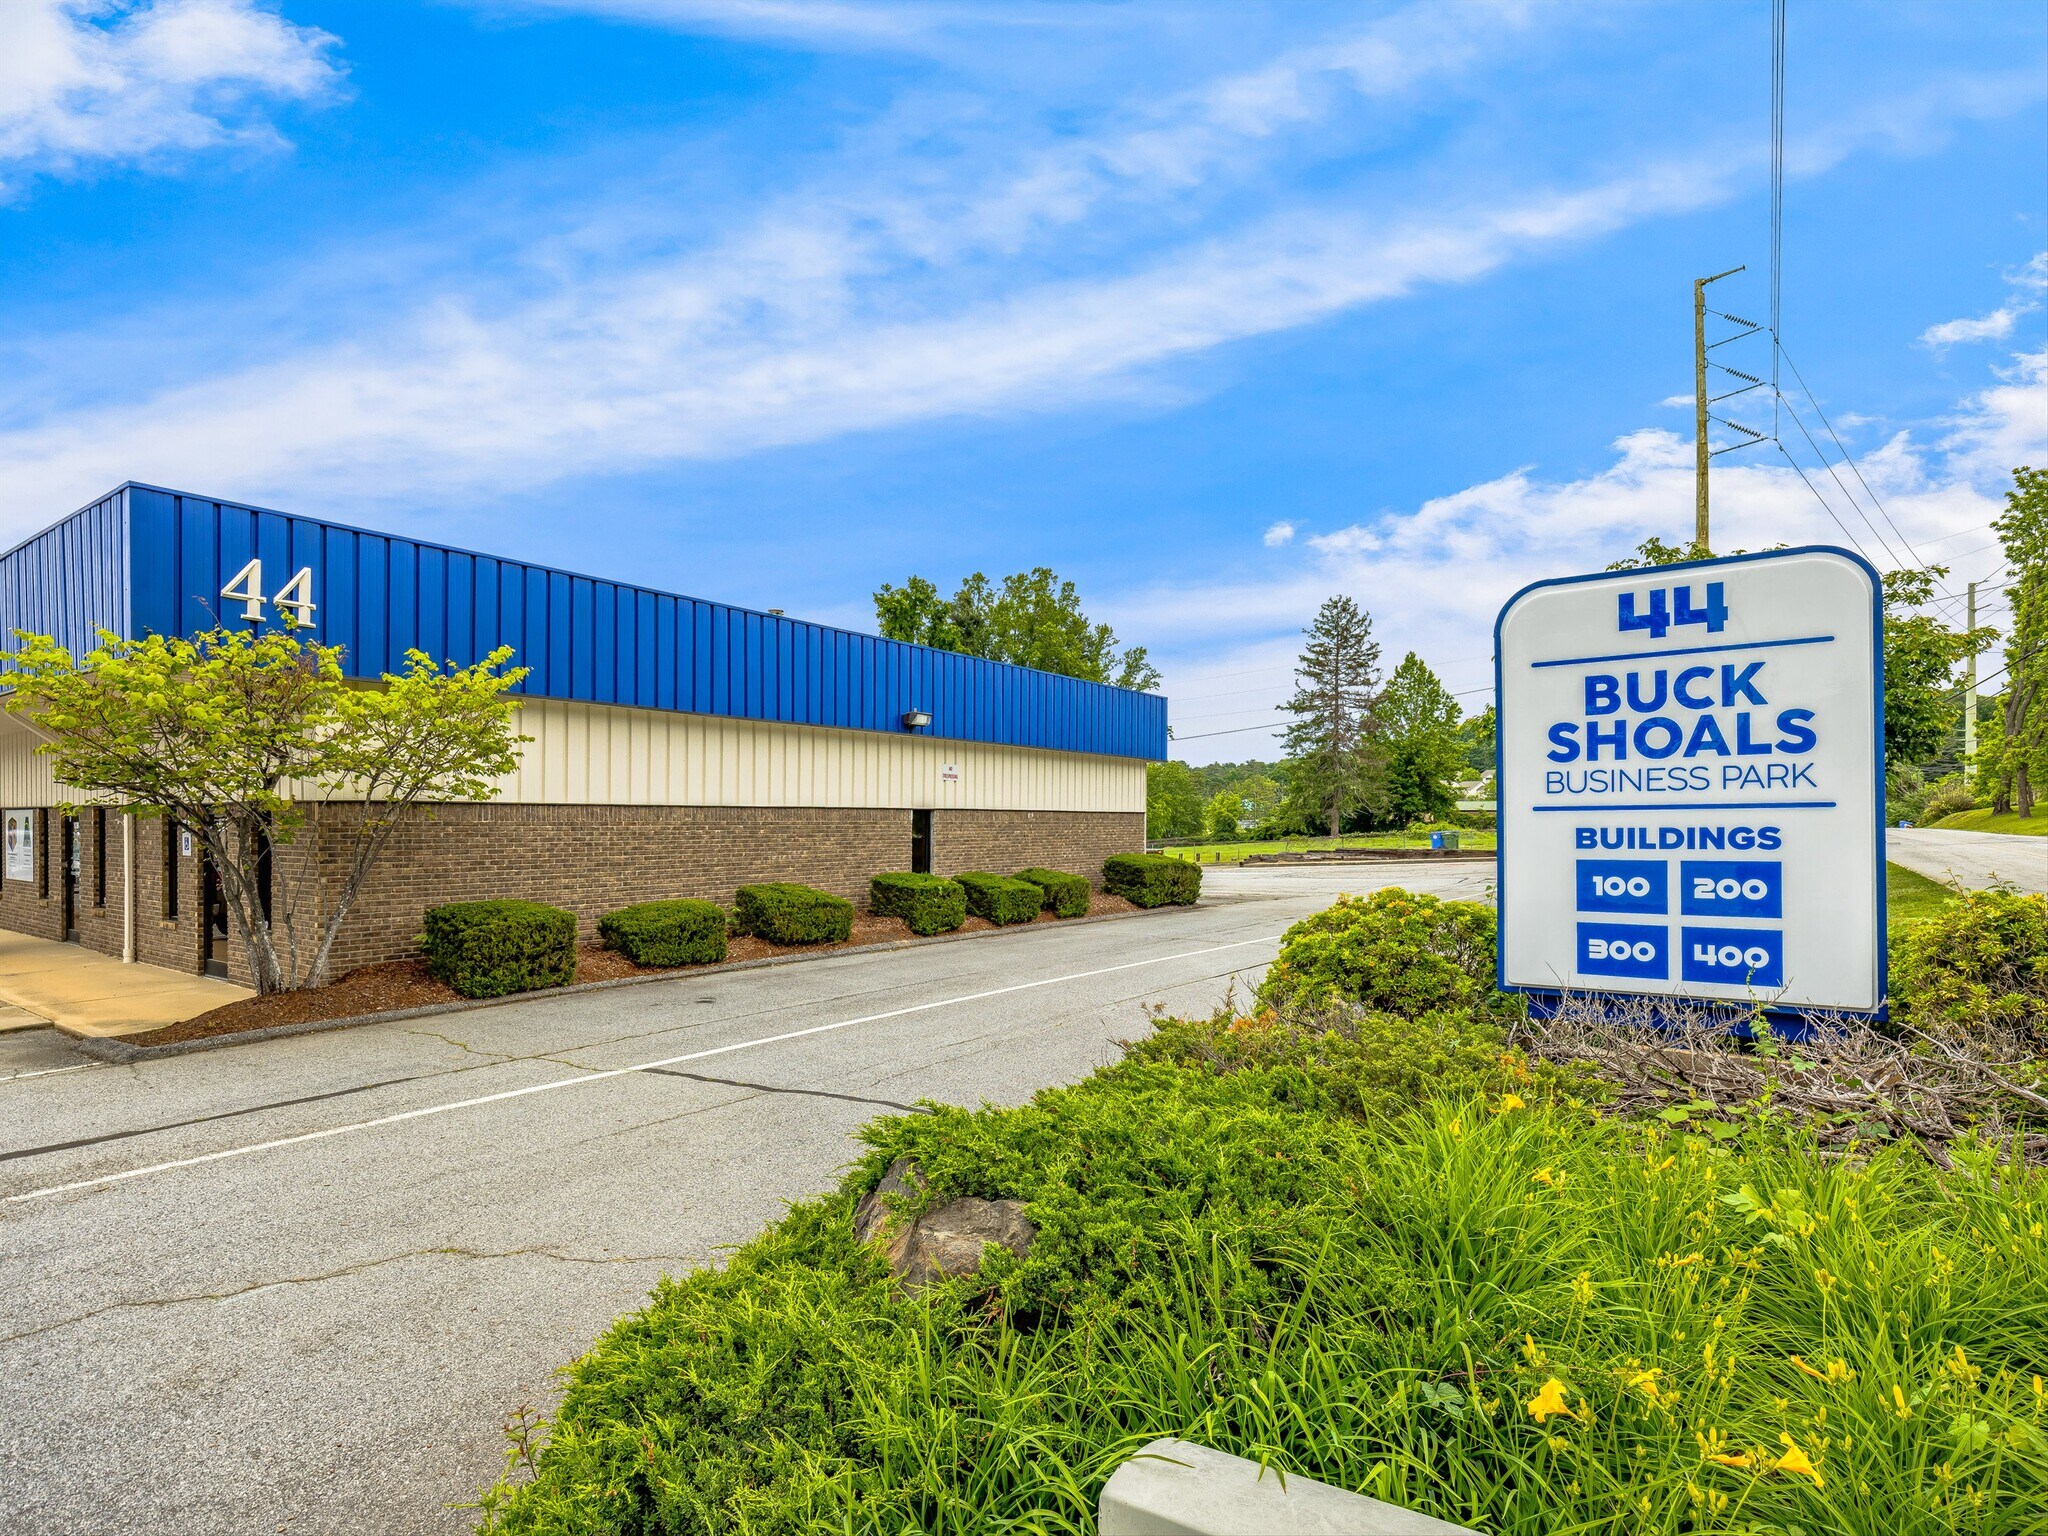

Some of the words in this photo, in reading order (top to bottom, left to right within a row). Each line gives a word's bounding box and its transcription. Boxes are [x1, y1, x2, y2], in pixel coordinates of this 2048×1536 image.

[221, 558, 317, 628] 44
[1618, 582, 1729, 639] 44
[1585, 661, 1768, 716] BUCK
[1546, 708, 1818, 763] SHOALS
[1545, 767, 1710, 795] BUSINESS
[1722, 762, 1818, 789] PARK
[1575, 826, 1782, 851] BUILDINGS
[1592, 875, 1651, 897] 100
[1693, 877, 1768, 900] 200
[1588, 938, 1656, 961] 300
[1693, 943, 1770, 968] 400
